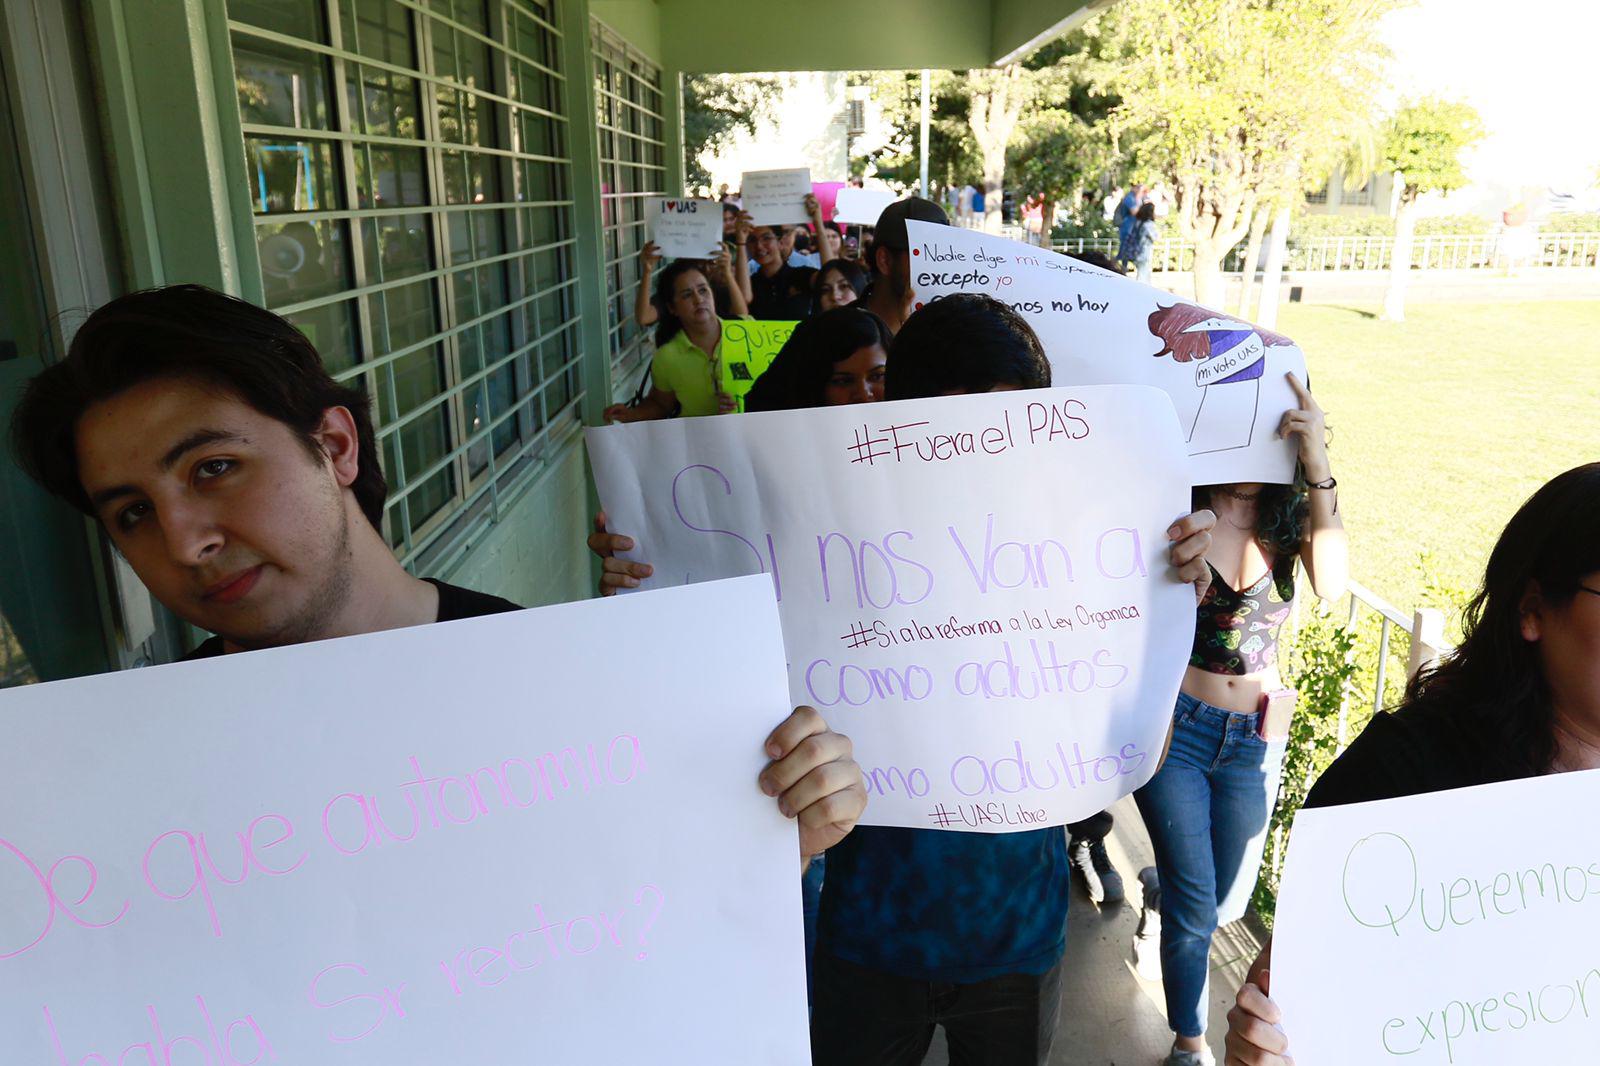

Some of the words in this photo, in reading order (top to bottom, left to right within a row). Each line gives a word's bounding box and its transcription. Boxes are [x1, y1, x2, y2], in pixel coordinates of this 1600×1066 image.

[676, 200, 697, 214] UAS
[923, 243, 967, 263] Nadie
[973, 247, 1007, 269] elige
[1015, 256, 1040, 266] mi
[917, 269, 990, 290] excepto
[996, 276, 1013, 291] yo
[1051, 301, 1073, 314] no
[1077, 293, 1109, 313] hay
[1237, 344, 1259, 361] UAS
[1027, 399, 1090, 445] PAS
[816, 529, 935, 610] nos
[1095, 526, 1150, 580] a
[1008, 616, 1022, 631] a
[1023, 609, 1043, 631] la
[1045, 608, 1073, 632] Ley
[1075, 604, 1140, 630] Organica
[954, 638, 1129, 700] adultos
[950, 740, 1147, 797] adultos
[142, 813, 310, 938] que
[321, 733, 648, 856] autonomia
[308, 963, 407, 1043] Sr
[439, 883, 665, 995] rector?
